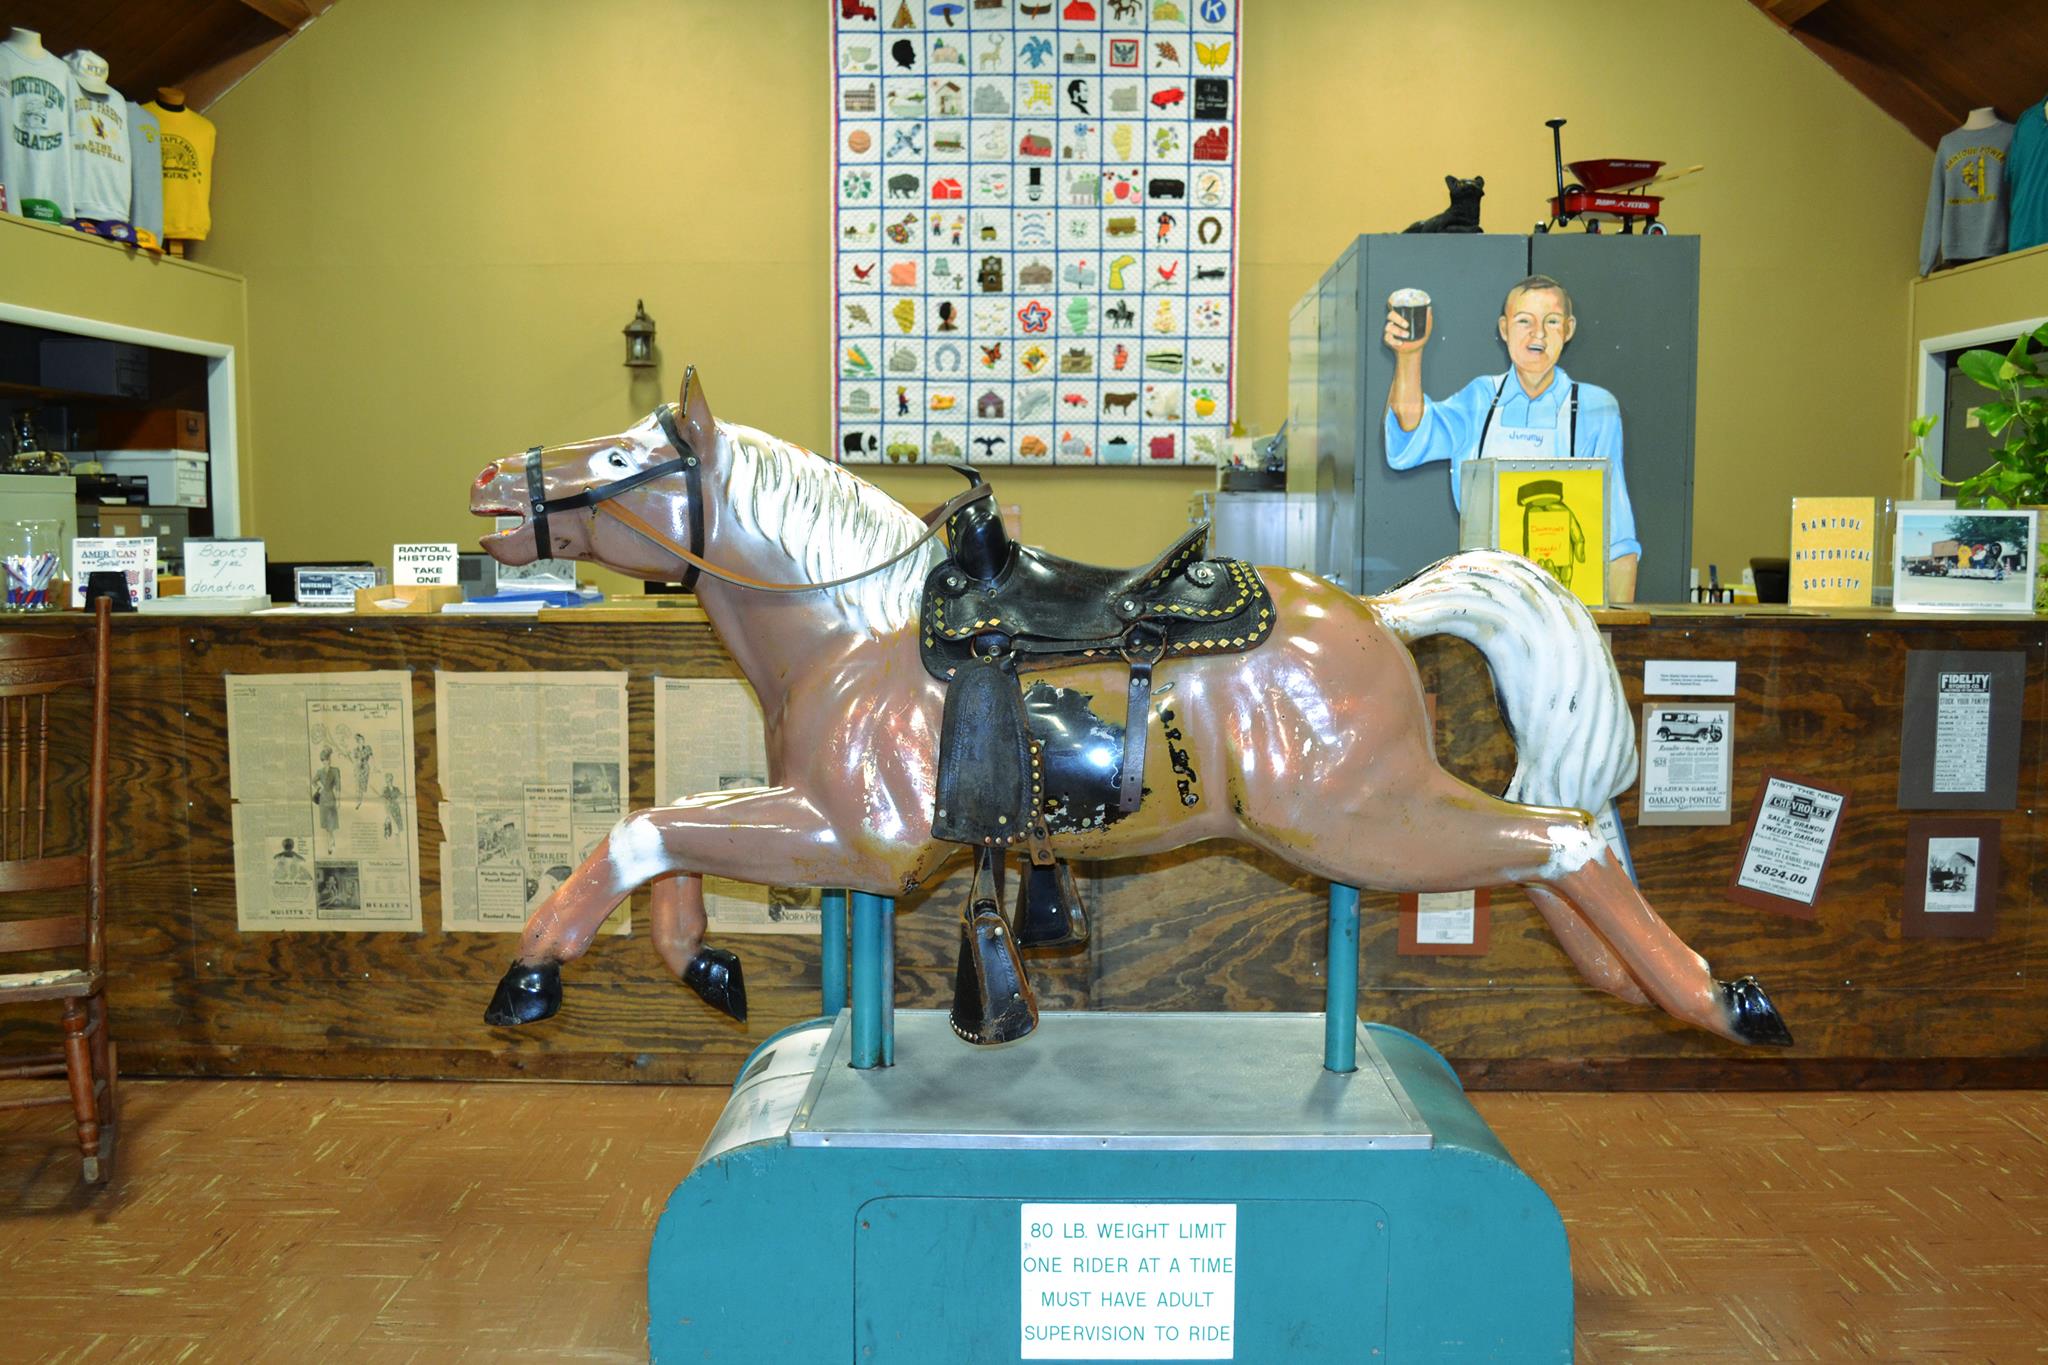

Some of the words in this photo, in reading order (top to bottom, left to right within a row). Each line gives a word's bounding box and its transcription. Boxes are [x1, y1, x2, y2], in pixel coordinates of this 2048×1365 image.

[1509, 430, 1544, 447] Jimmy
[1801, 518, 1861, 532] RANTOUL
[1796, 549, 1870, 561] HISTORICAL
[191, 579, 257, 593] donation
[1804, 578, 1860, 590] SOCIETY
[1942, 674, 1989, 689] FIDELITY
[1771, 781, 1793, 790] VISIT
[1796, 788, 1815, 796] THE
[1817, 793, 1841, 802] NEW
[1773, 796, 1830, 818] CHEVROLET
[1767, 814, 1791, 825] SALES
[1793, 821, 1826, 833] BRANCH
[1761, 824, 1793, 836] TWEEDY
[1793, 832, 1825, 846] GARAGE
[1753, 863, 1807, 884] $824.00
[1030, 1222, 1053, 1239] 80
[1063, 1223, 1088, 1239] LB.
[1097, 1223, 1170, 1239] WEIGHT
[1179, 1223, 1226, 1239] LIMIT
[1023, 1257, 1062, 1273] ONE
[1073, 1257, 1128, 1273] RIDER
[1138, 1257, 1160, 1273] AT
[1169, 1257, 1181, 1273] A
[1190, 1257, 1233, 1273] TIME
[1041, 1291, 1091, 1308] MUST
[1101, 1291, 1147, 1308] HAVE
[1157, 1291, 1214, 1308] ADULT
[1024, 1325, 1145, 1342] SUPERVISION
[1155, 1325, 1179, 1342] TO
[1189, 1325, 1231, 1342] RIDE
